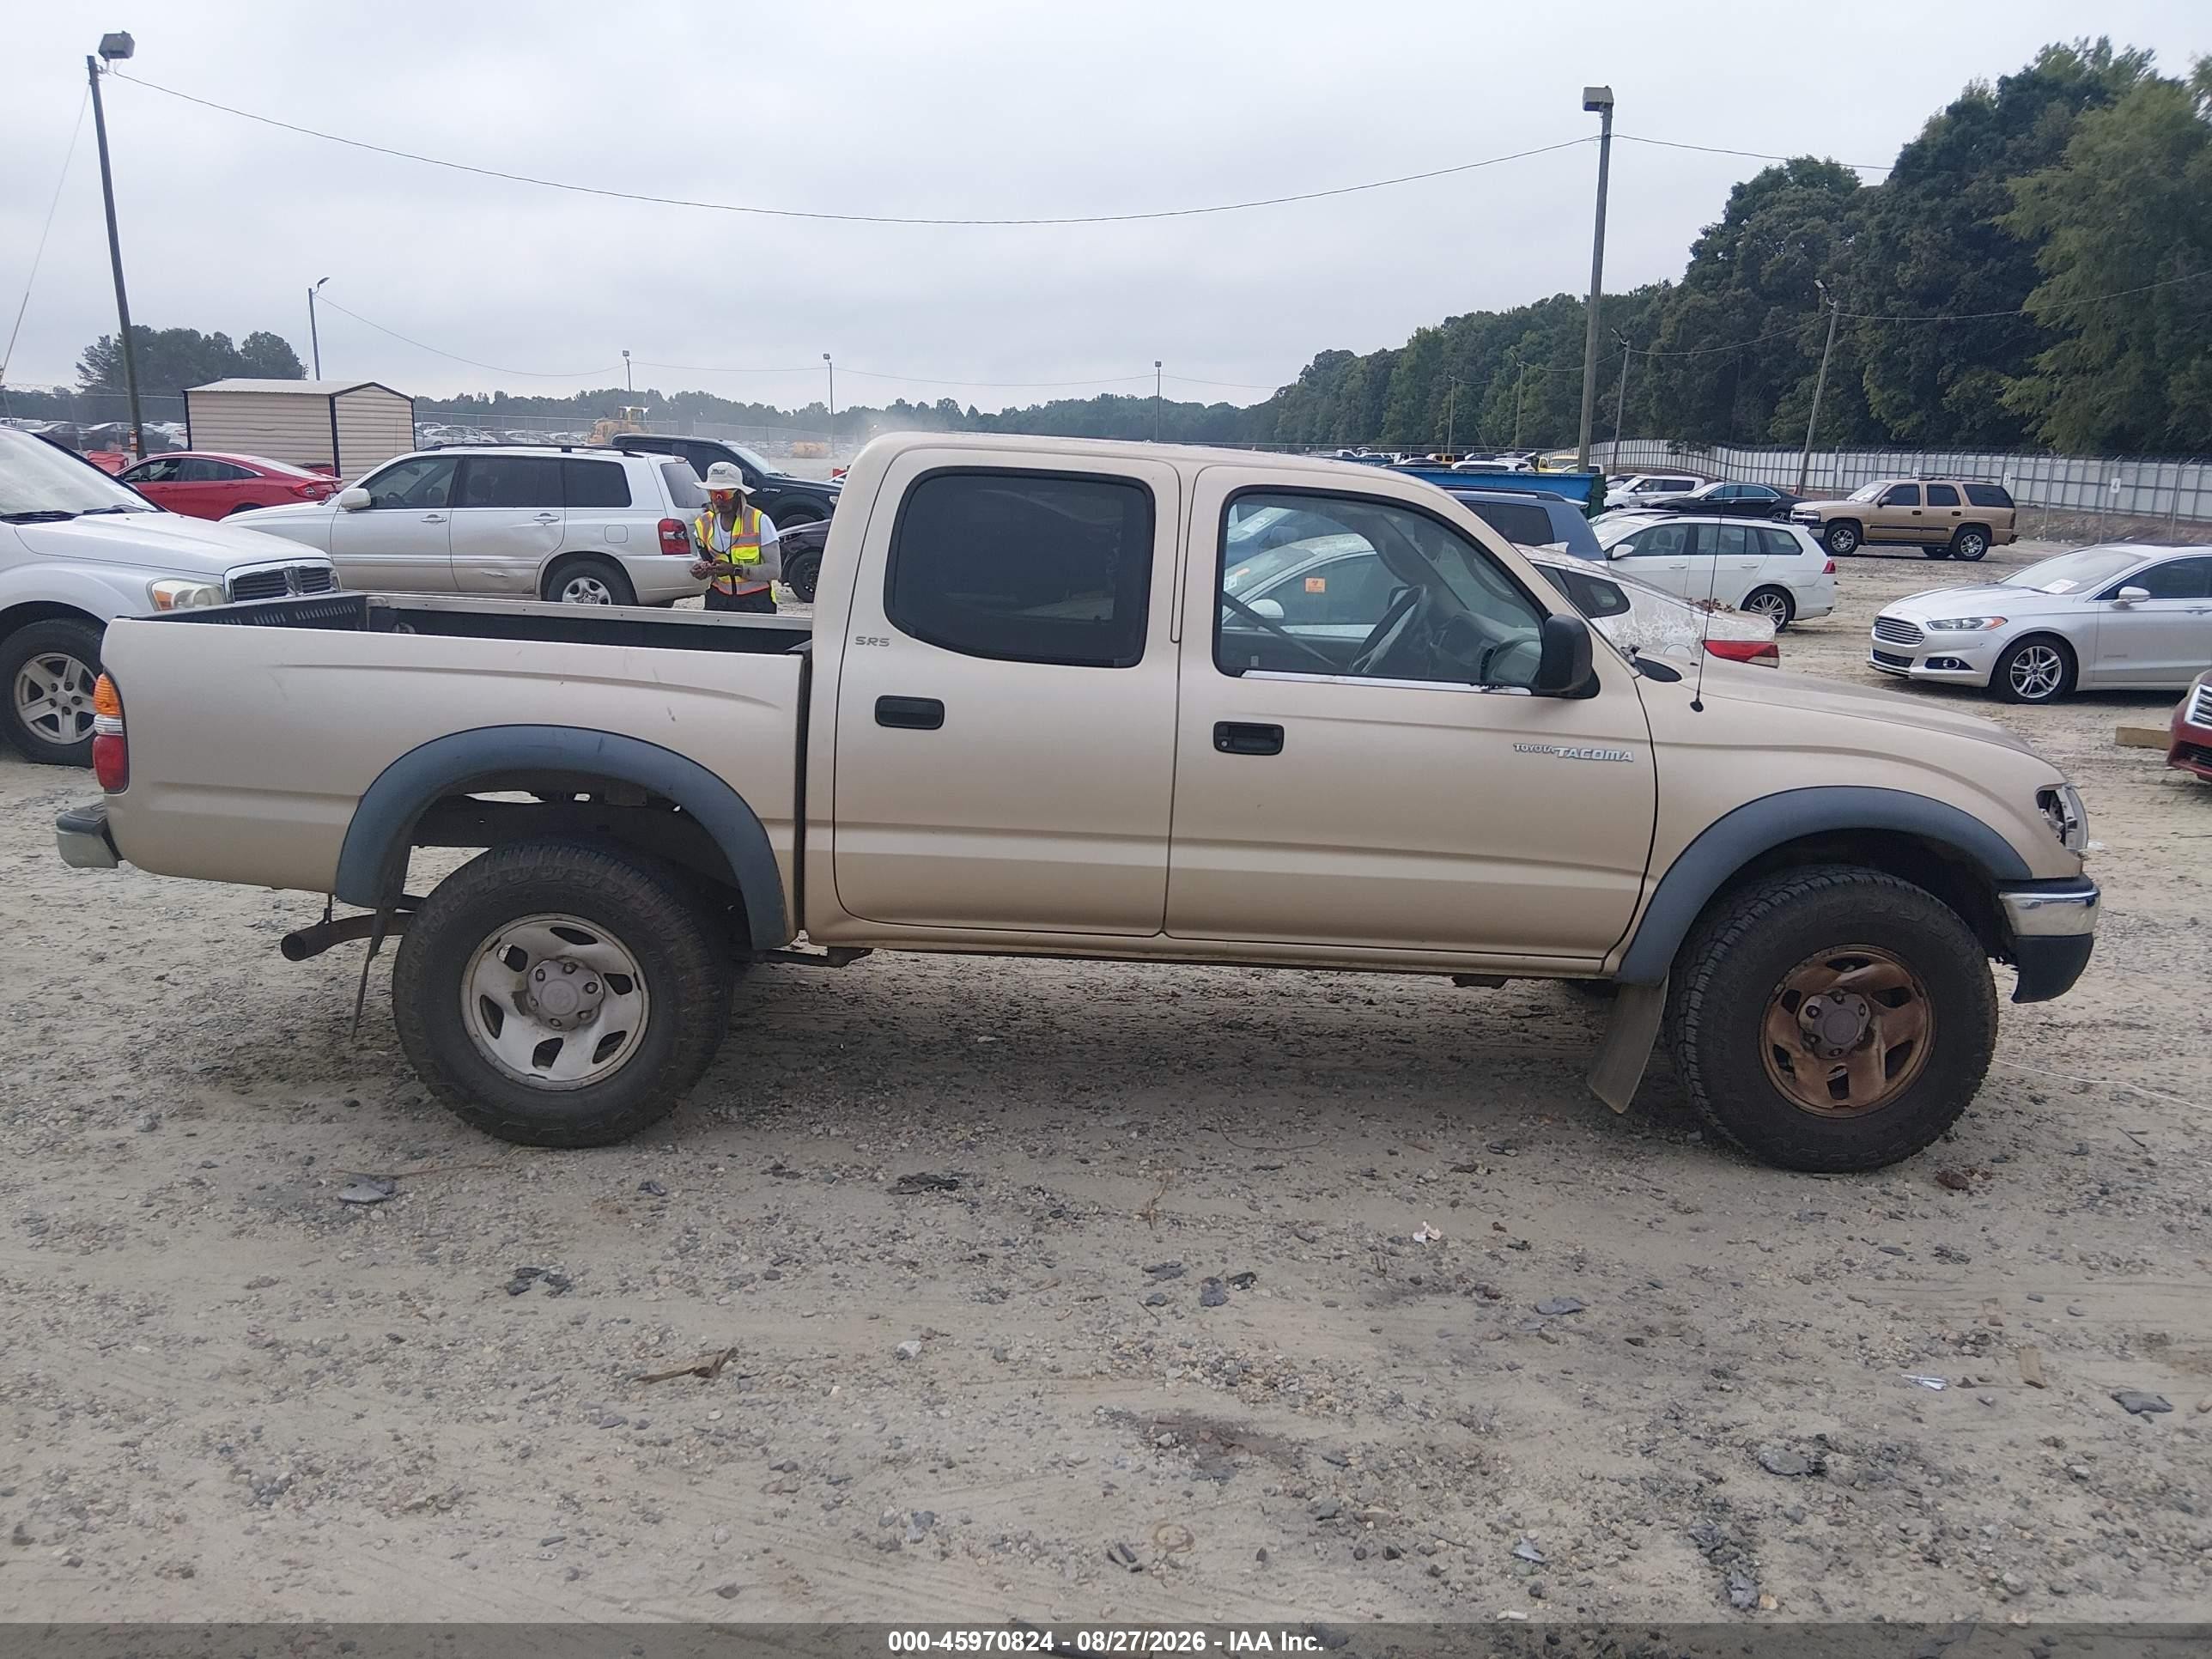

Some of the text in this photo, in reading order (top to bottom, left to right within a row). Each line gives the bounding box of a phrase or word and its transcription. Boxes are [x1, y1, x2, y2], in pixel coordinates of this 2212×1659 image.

[854, 636, 890, 647] SRS
[1513, 744, 1633, 762] TOYOTA TACOMA
